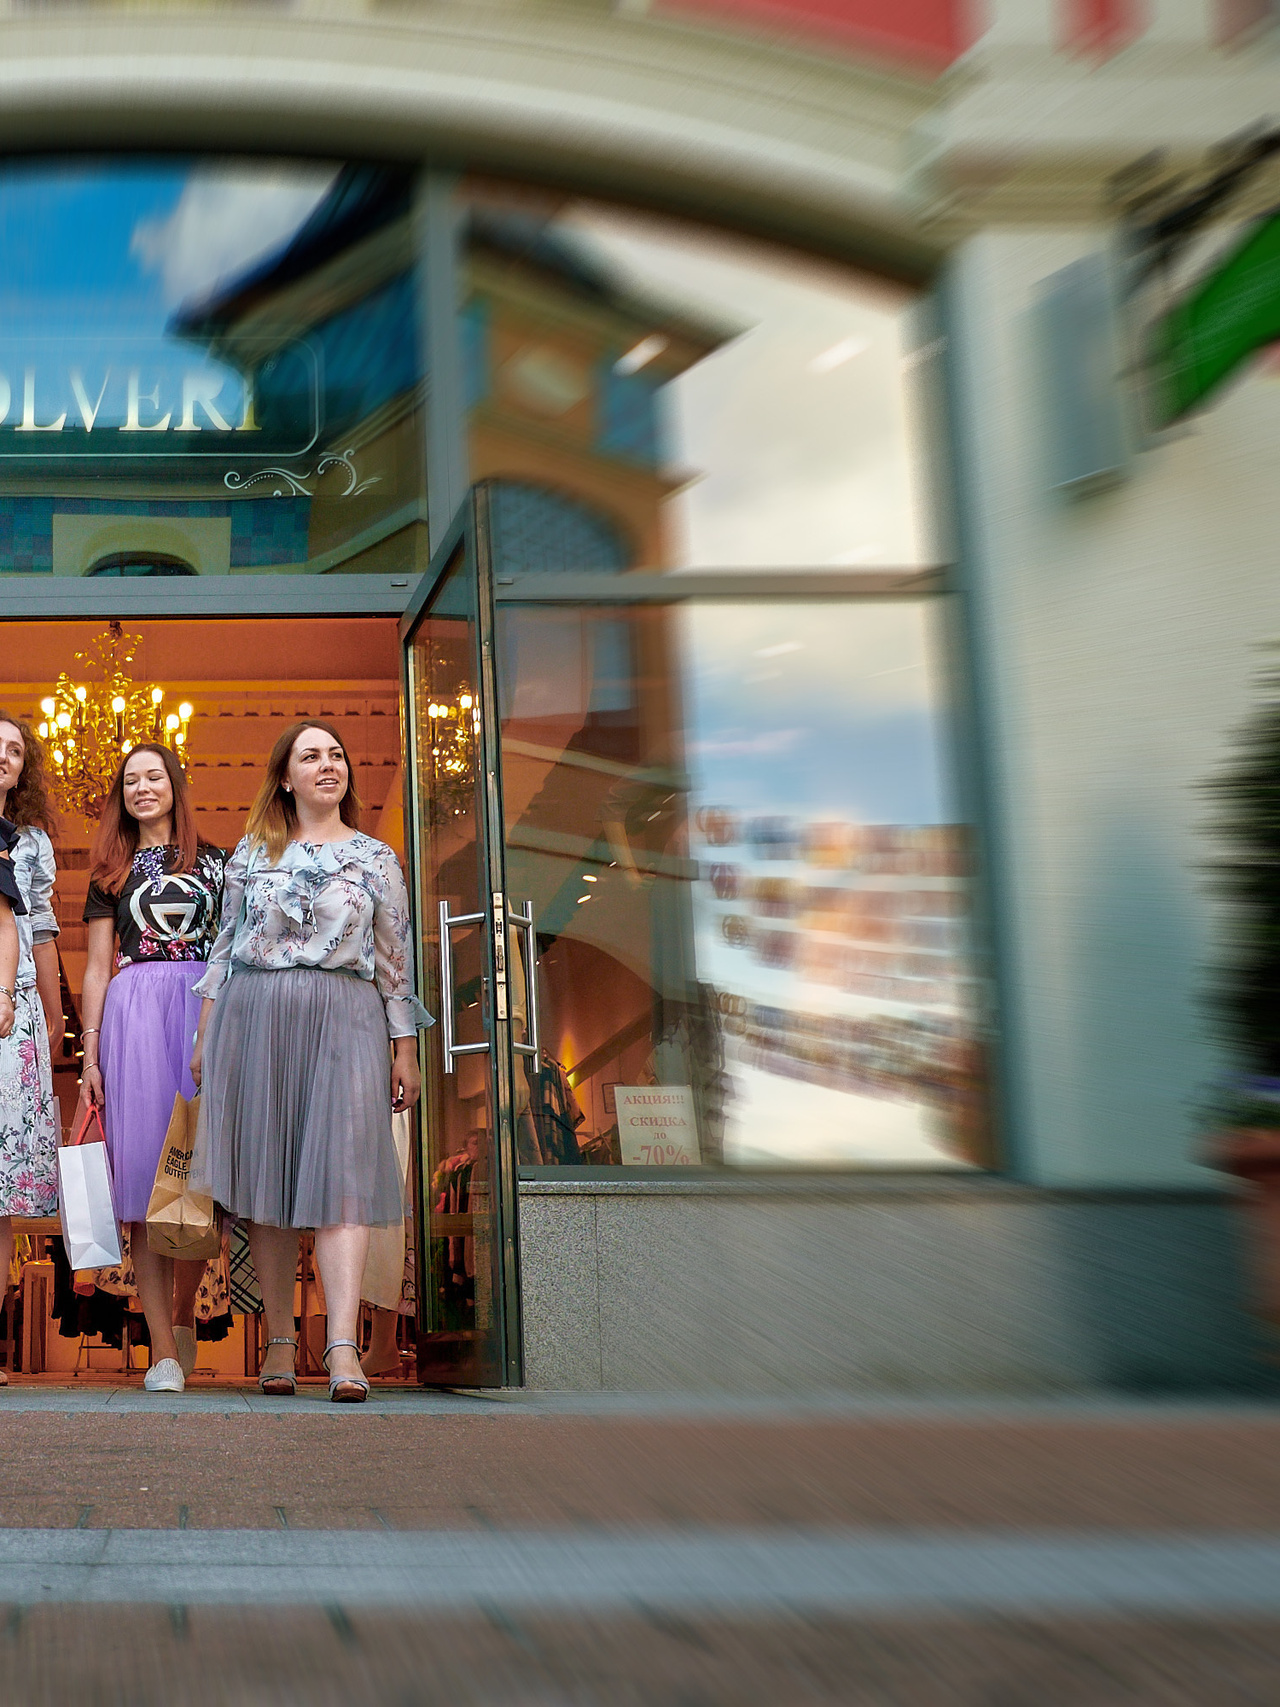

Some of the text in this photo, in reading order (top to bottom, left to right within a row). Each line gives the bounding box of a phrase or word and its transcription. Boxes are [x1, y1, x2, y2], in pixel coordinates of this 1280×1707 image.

[623, 1094, 685, 1105] АКЦИЯ!!!
[629, 1116, 687, 1127] СКИДКА
[632, 1144, 690, 1165] -70%
[167, 1155, 187, 1171] EAGLE
